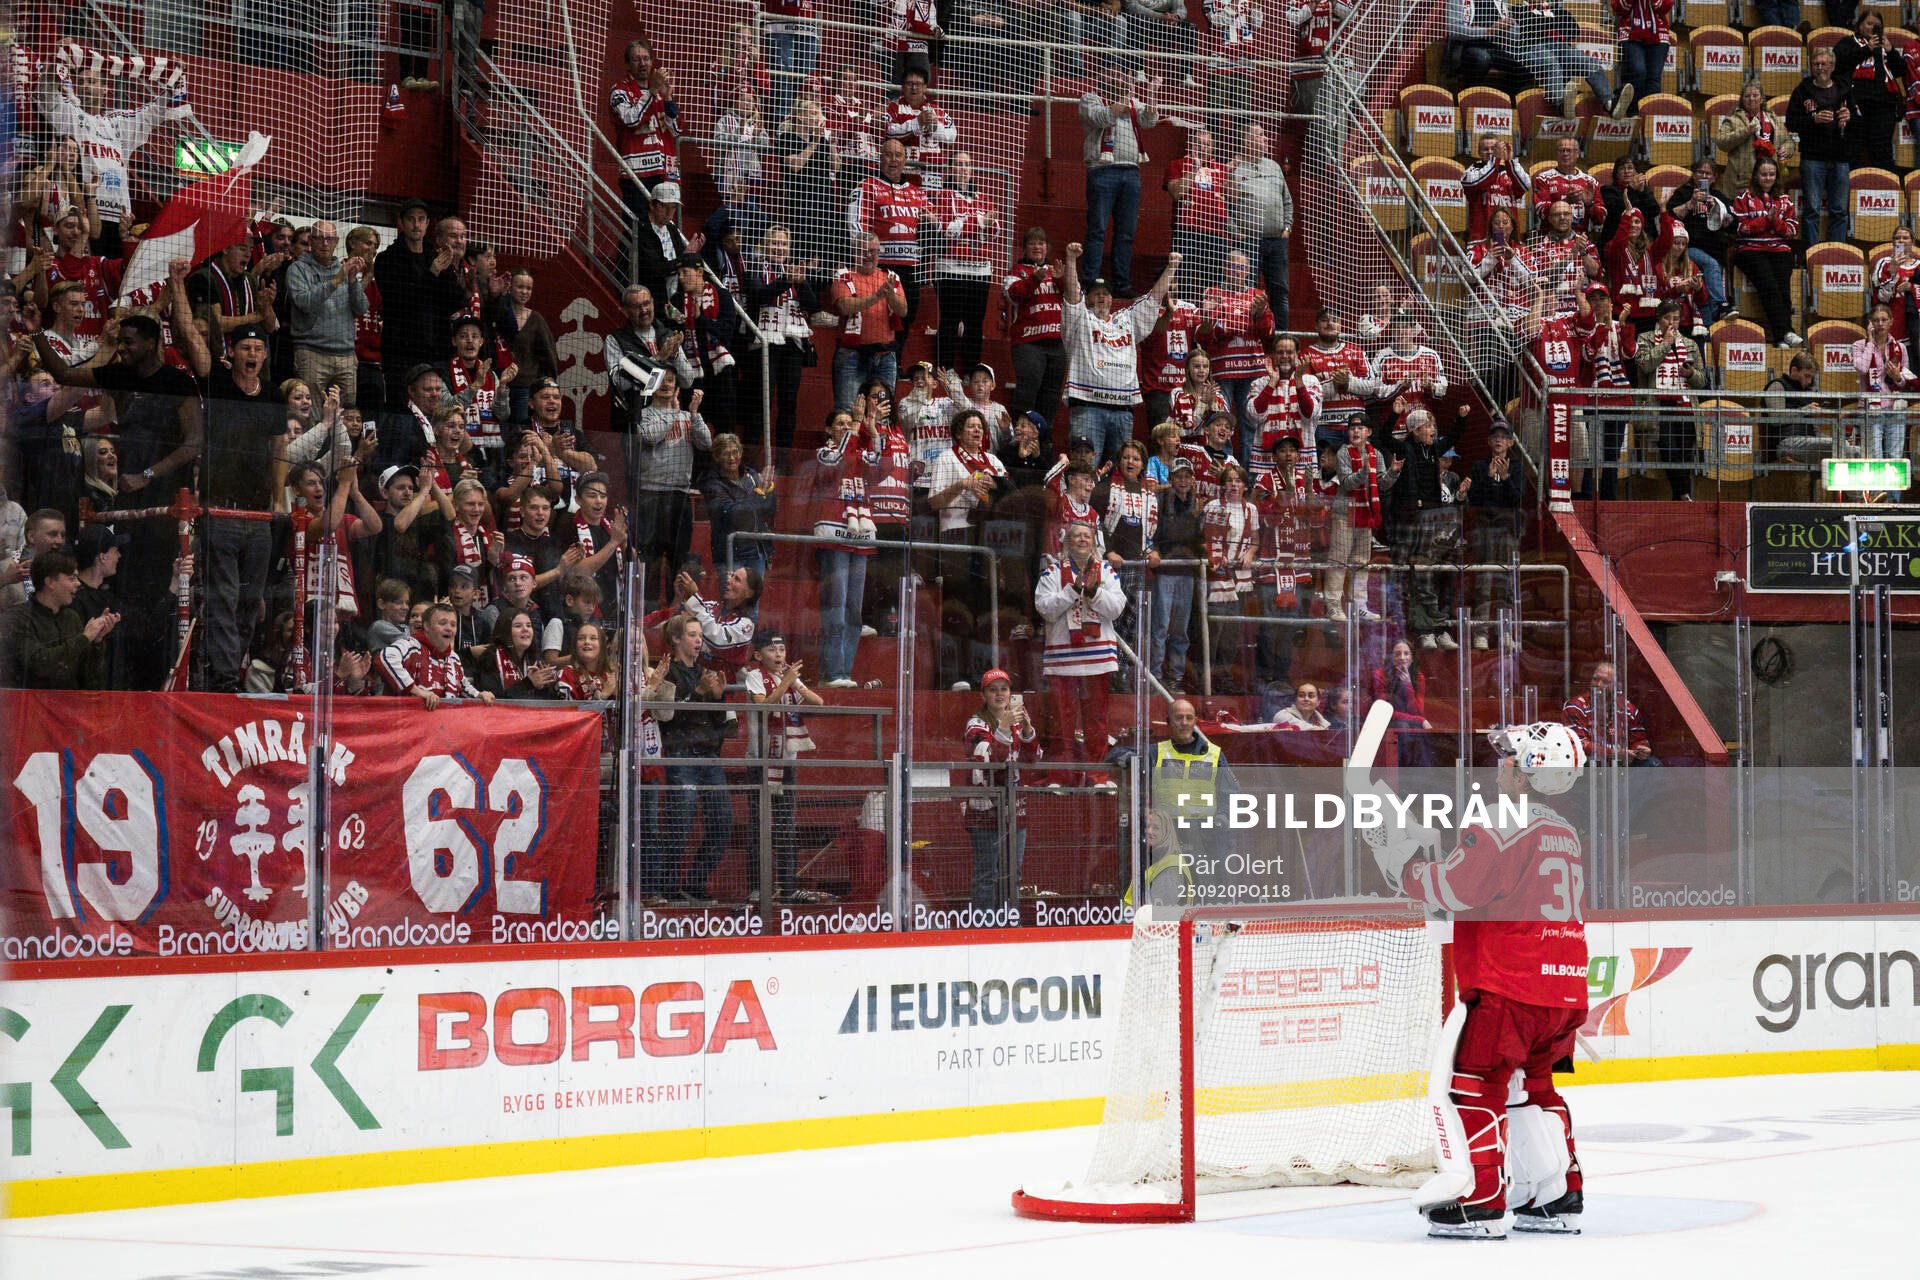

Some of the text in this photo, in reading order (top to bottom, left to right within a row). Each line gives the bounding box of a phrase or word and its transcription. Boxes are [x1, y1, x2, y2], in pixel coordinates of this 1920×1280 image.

[1706, 51, 1741, 64] MAXI
[1764, 52, 1799, 65] MAXI
[1418, 111, 1452, 124] MAXI
[1476, 114, 1510, 127] MAXI
[1597, 123, 1632, 135] MAXI
[1655, 121, 1690, 134] MAXI
[1859, 196, 1895, 208] MAXI
[1825, 271, 1861, 284] MAXI
[1728, 349, 1763, 362] MAXI
[1724, 434, 1750, 446] AXI
[1810, 551, 1910, 577] HUSET
[201, 711, 307, 788] TIMRÅ
[12, 751, 542, 922] 19 62
[195, 812, 366, 861] 19 62
[890, 973, 1102, 1031] EUROCON
[417, 979, 778, 1072] BORGA
[937, 1039, 1103, 1071] PART OF REJLERS
[196, 993, 385, 1137] GK
[503, 1082, 703, 1114] BYGG BEKYMMERSFRITT
